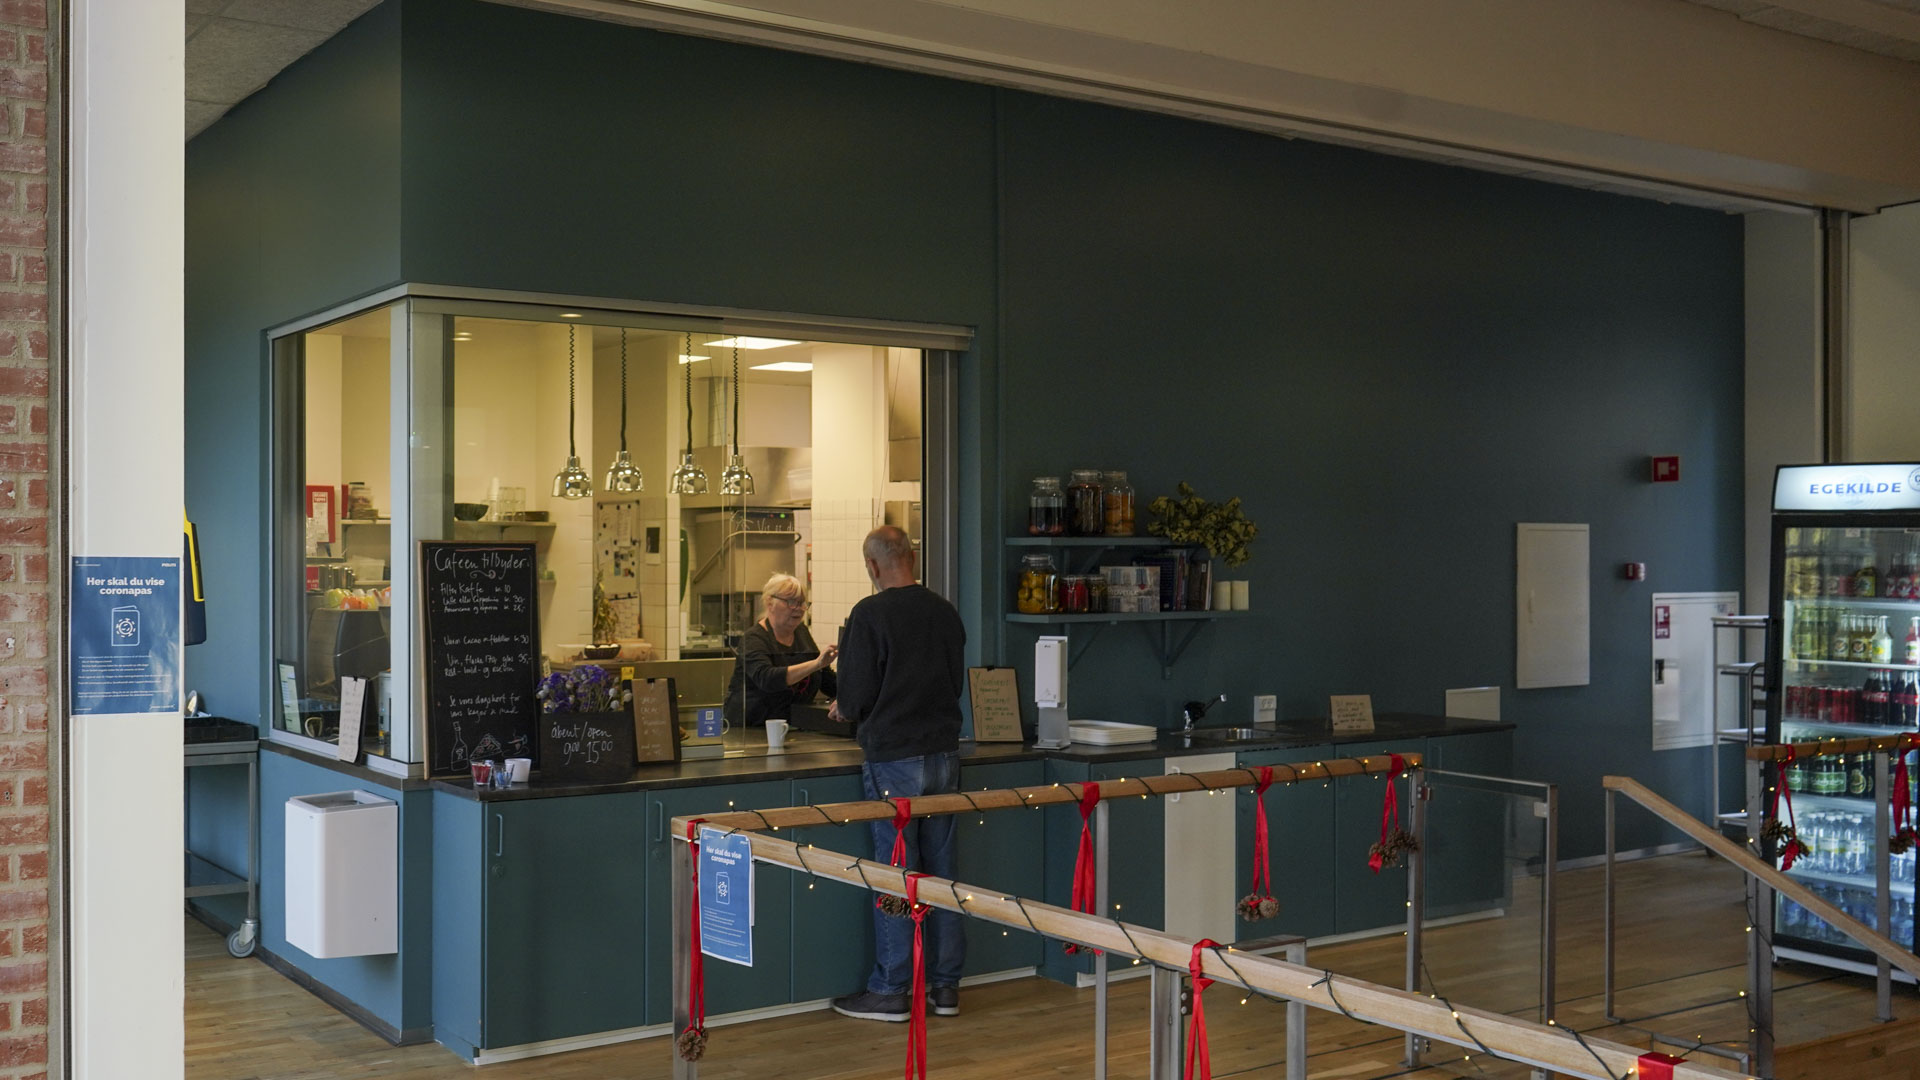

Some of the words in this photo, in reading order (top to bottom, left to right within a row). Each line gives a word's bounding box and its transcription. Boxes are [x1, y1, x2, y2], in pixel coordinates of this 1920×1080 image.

[1809, 482, 1903, 494] EGEKILDE
[86, 577, 106, 586] Her
[107, 577, 129, 586] skal
[129, 577, 144, 586] du
[144, 577, 166, 586] vise
[99, 587, 153, 597] coronapas
[706, 845, 714, 853] Her
[714, 847, 724, 856] skal
[724, 849, 731, 857] du
[731, 851, 742, 859] vise
[711, 855, 735, 865] coronapas
